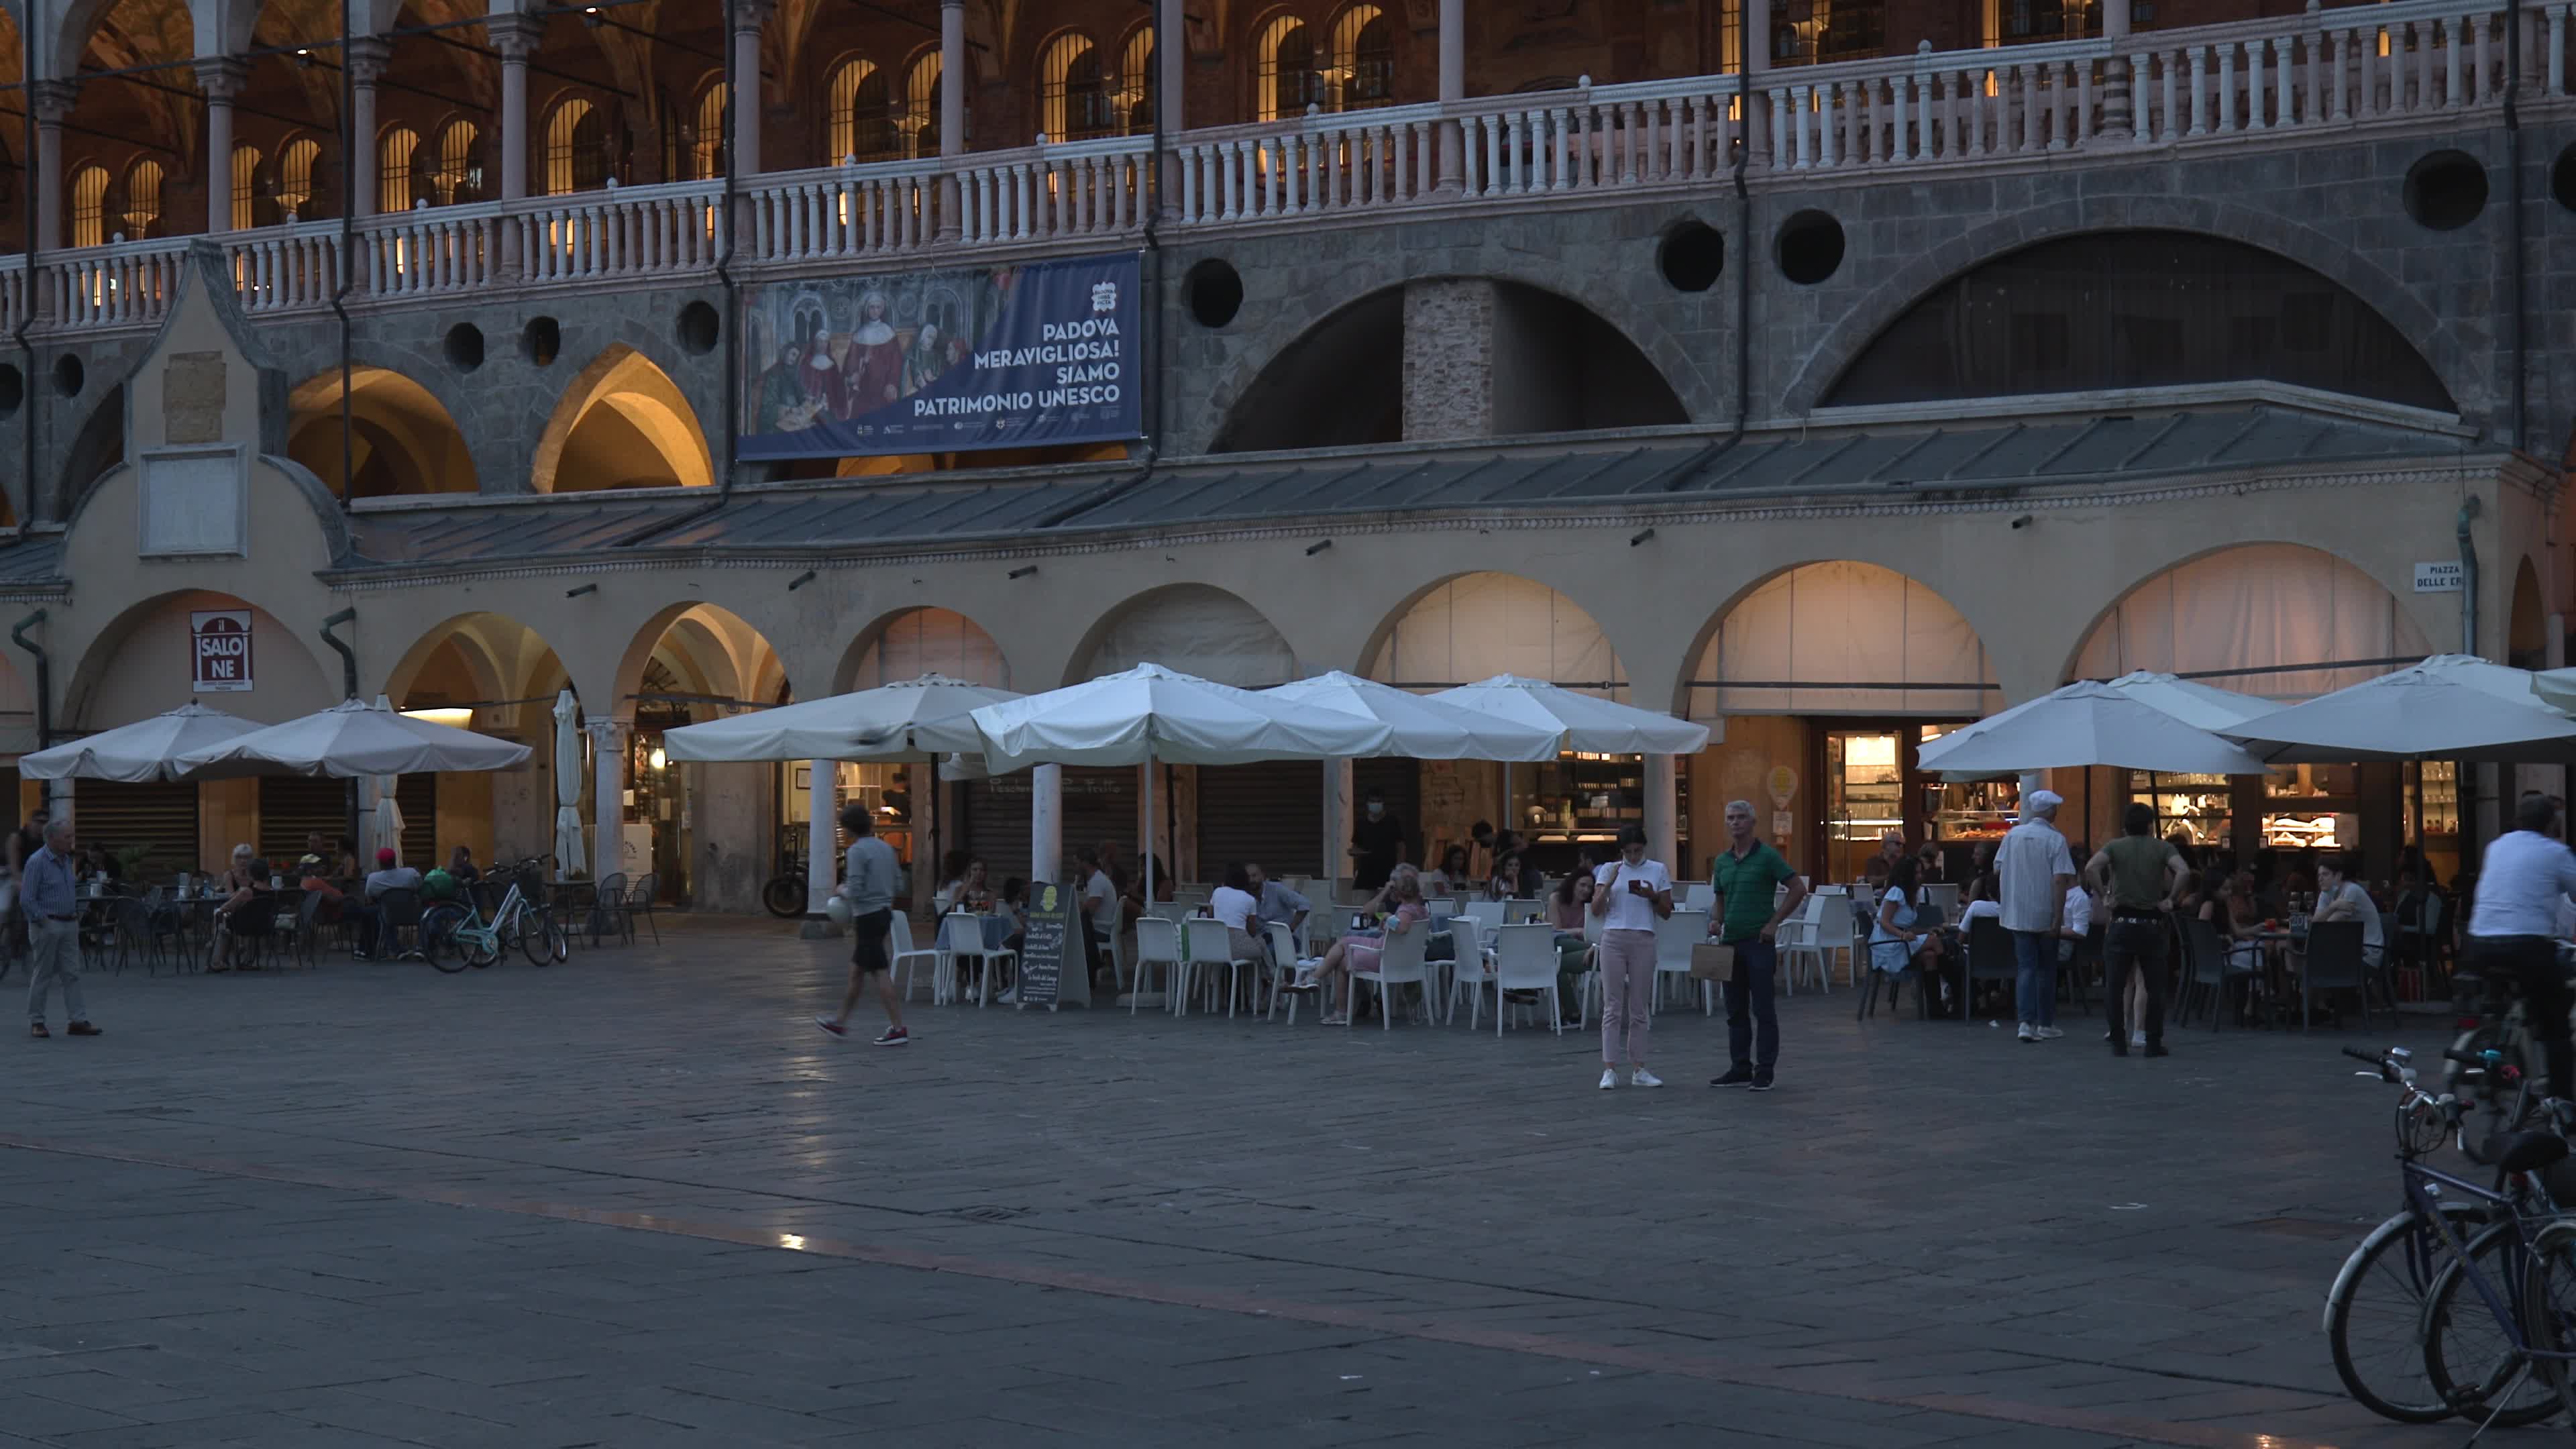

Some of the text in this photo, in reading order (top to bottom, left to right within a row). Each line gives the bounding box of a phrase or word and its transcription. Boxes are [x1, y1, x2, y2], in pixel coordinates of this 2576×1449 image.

[1042, 317, 1120, 341] PADOVA
[974, 339, 1120, 370] MERAVIGLIOSA!
[1057, 362, 1120, 384] SIAMO
[914, 384, 1120, 417] PATRIMONIO UNESCO
[2430, 566, 2459, 574] PIAZZA
[2417, 578, 2445, 587] DELLE
[218, 619, 225, 632] il
[201, 637, 243, 657] SALO
[211, 659, 235, 678] NE
